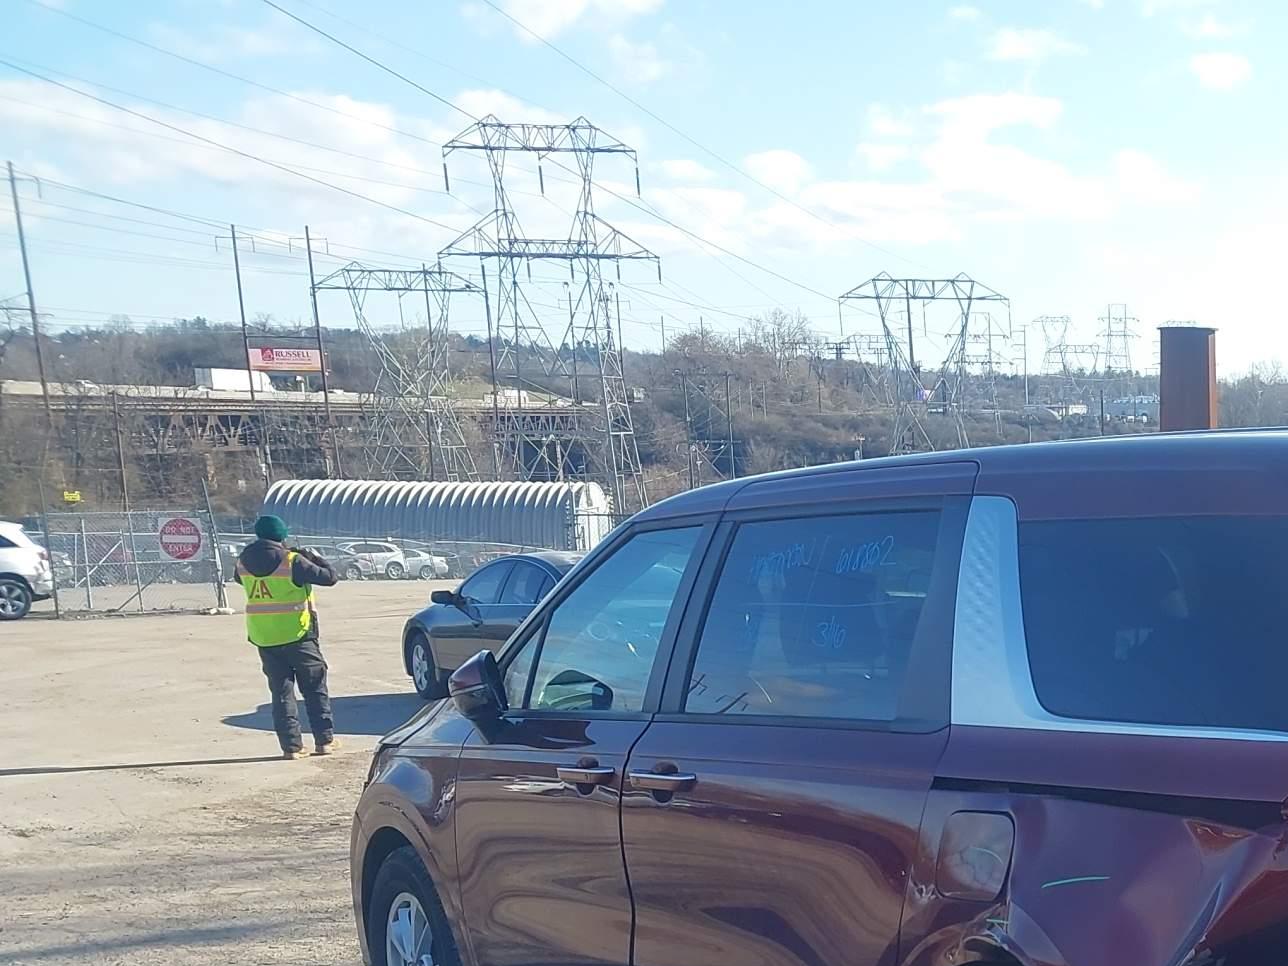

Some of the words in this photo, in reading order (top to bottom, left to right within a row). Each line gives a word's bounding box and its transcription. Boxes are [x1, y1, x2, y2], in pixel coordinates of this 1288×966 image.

[275, 350, 312, 359] RUSSELL
[165, 526, 177, 534] DO
[178, 526, 194, 534] NOT
[168, 544, 193, 553] ENTER
